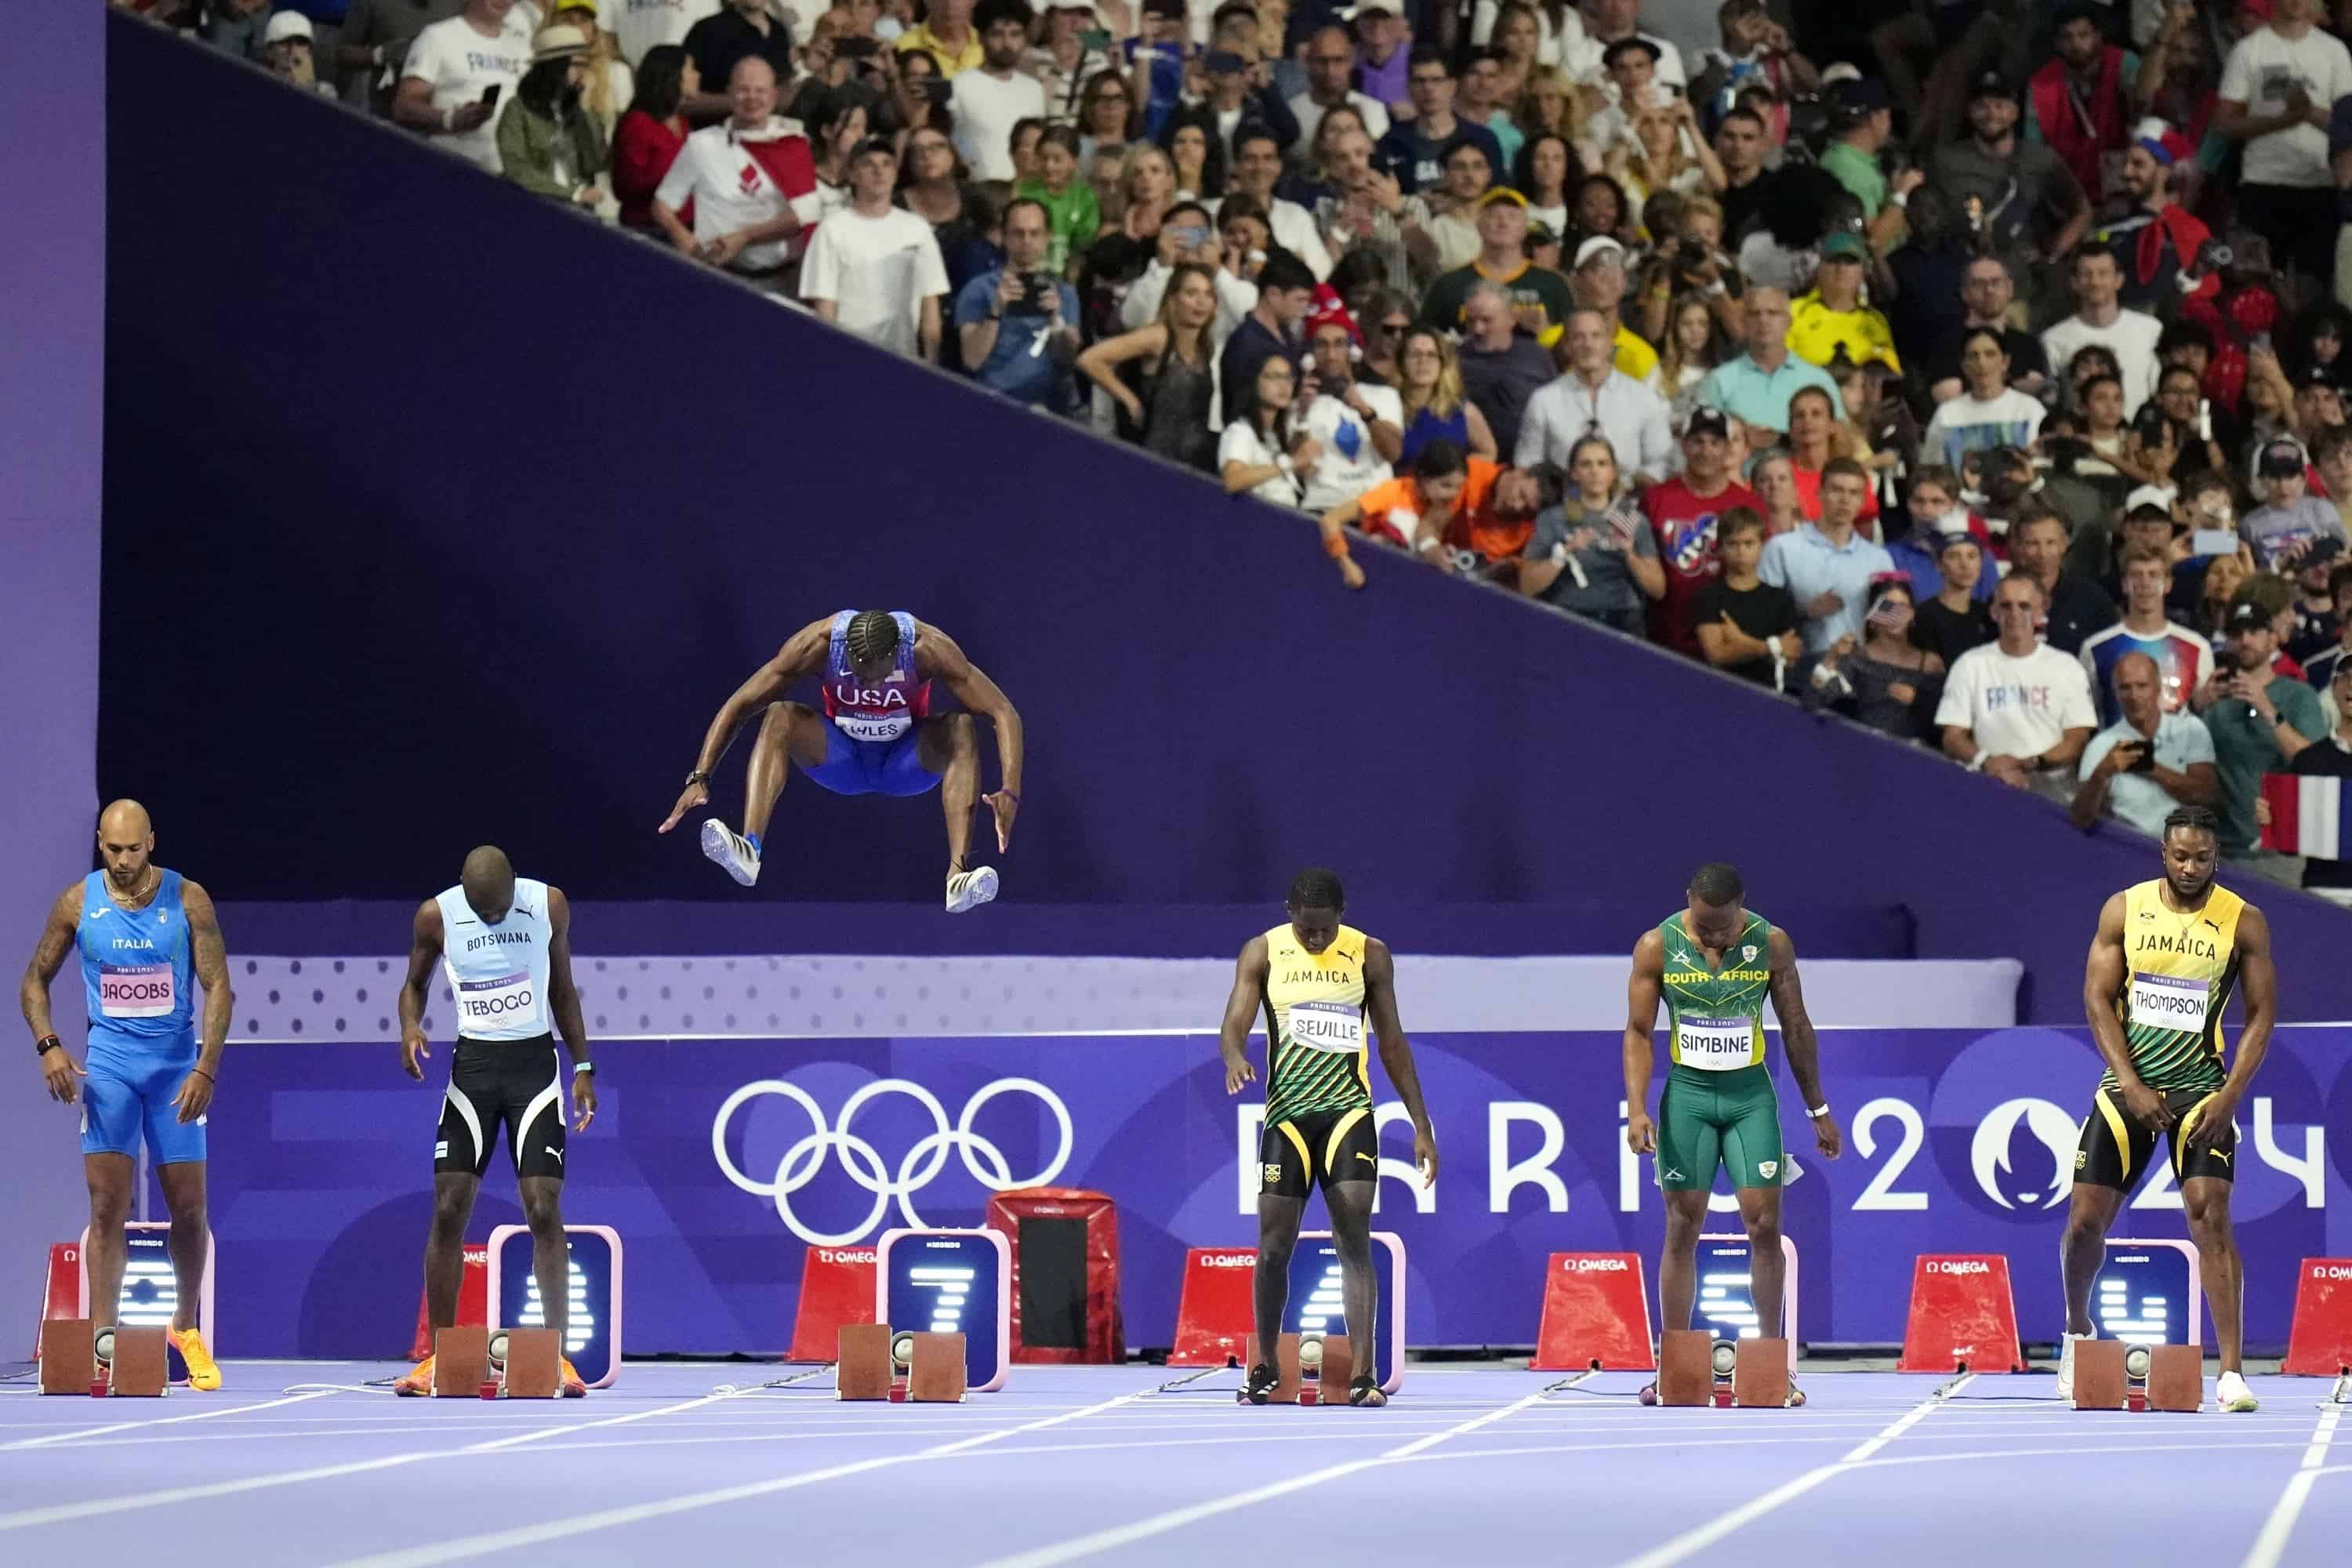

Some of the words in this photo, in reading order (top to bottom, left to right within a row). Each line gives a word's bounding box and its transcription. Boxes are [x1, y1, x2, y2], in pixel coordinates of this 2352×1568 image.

[837, 684, 907, 707] USA
[1986, 686, 2050, 711] FRANCE
[112, 938, 154, 949] ITALIA
[466, 932, 532, 952] BOTSWANA
[2135, 934, 2216, 960] JAMAICA
[1282, 970, 1350, 984] JAMAICA
[1663, 972, 1709, 984] SOUTH
[1718, 970, 1769, 981] AFRICA
[103, 982, 170, 1000] JACOBS
[463, 990, 532, 1016] TEBOGO
[2135, 990, 2205, 1016] THOMPSON
[1295, 1019, 1359, 1041] SEVILLE
[1681, 1033, 1749, 1053] SIMBINE
[1578, 1259, 1628, 1271] OMEGA
[1941, 1261, 1990, 1274] OMEGA
[909, 1267, 975, 1333] 7
